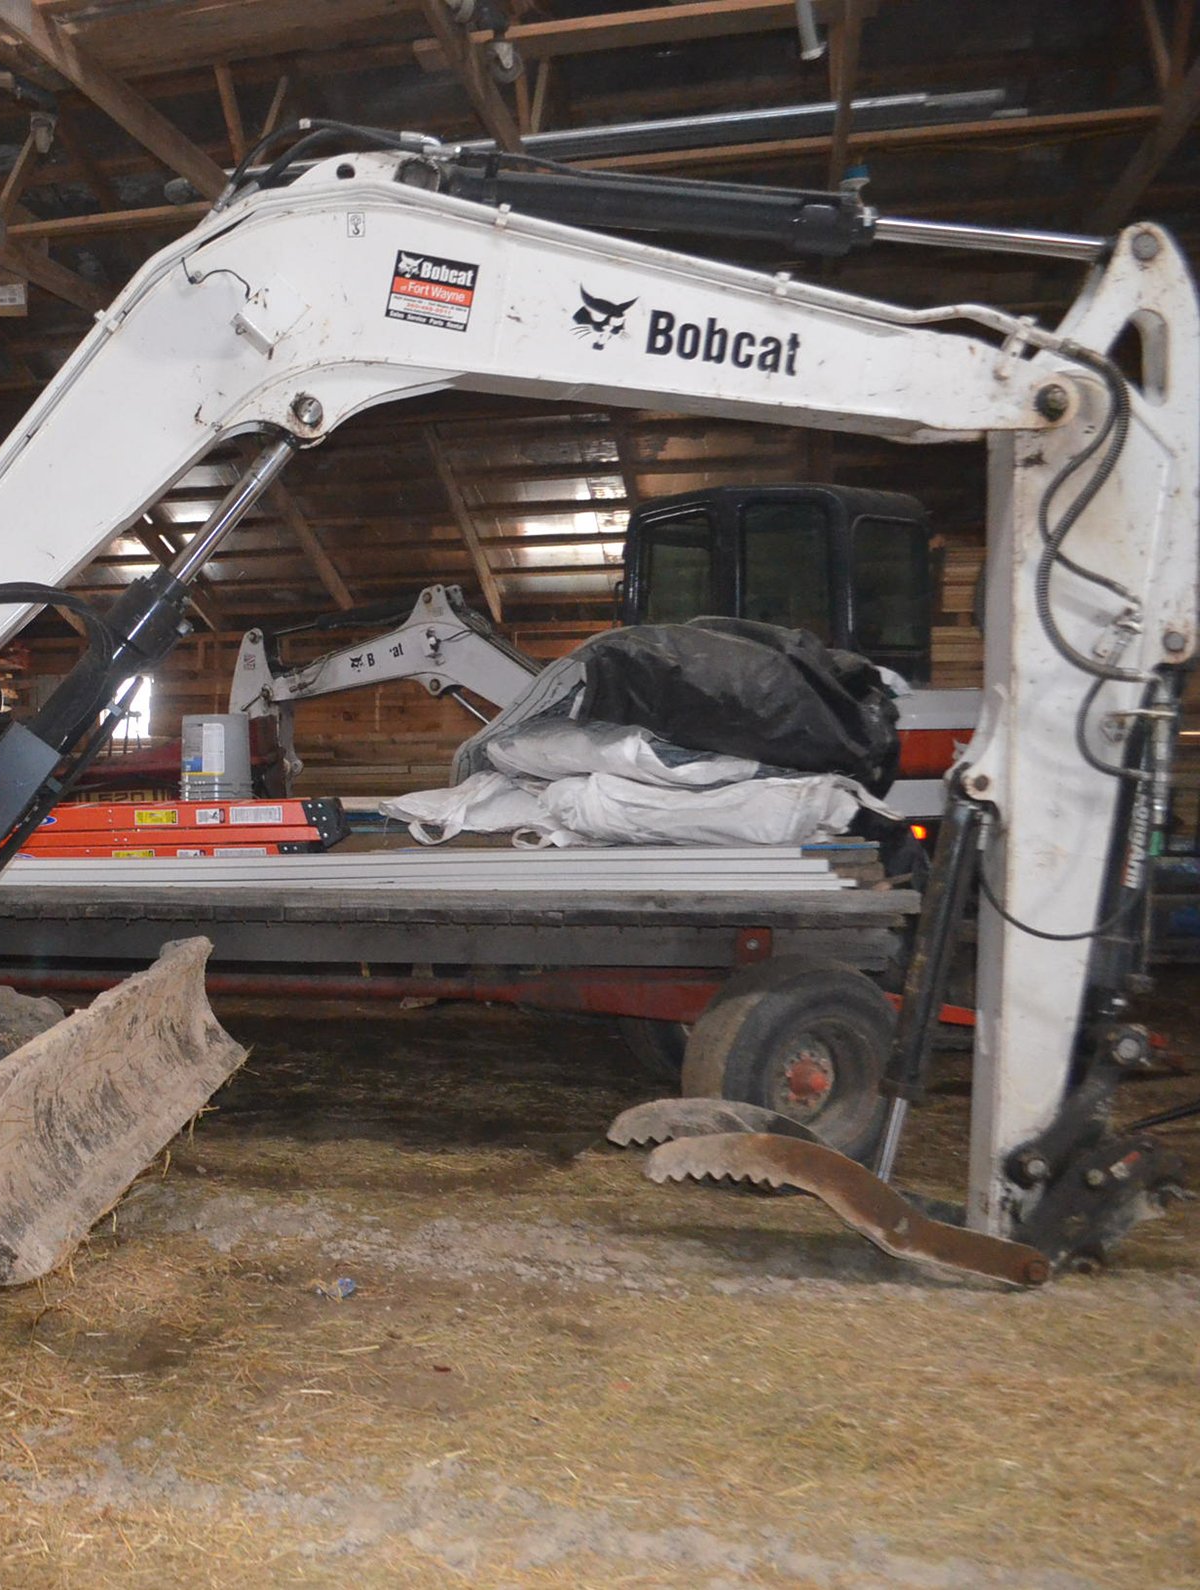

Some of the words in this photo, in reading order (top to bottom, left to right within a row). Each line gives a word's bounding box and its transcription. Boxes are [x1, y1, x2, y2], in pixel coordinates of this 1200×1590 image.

[420, 261, 474, 287] Bobcat
[408, 281, 430, 296] Fort
[432, 284, 466, 303] Wayne
[645, 308, 801, 377] Bobcat
